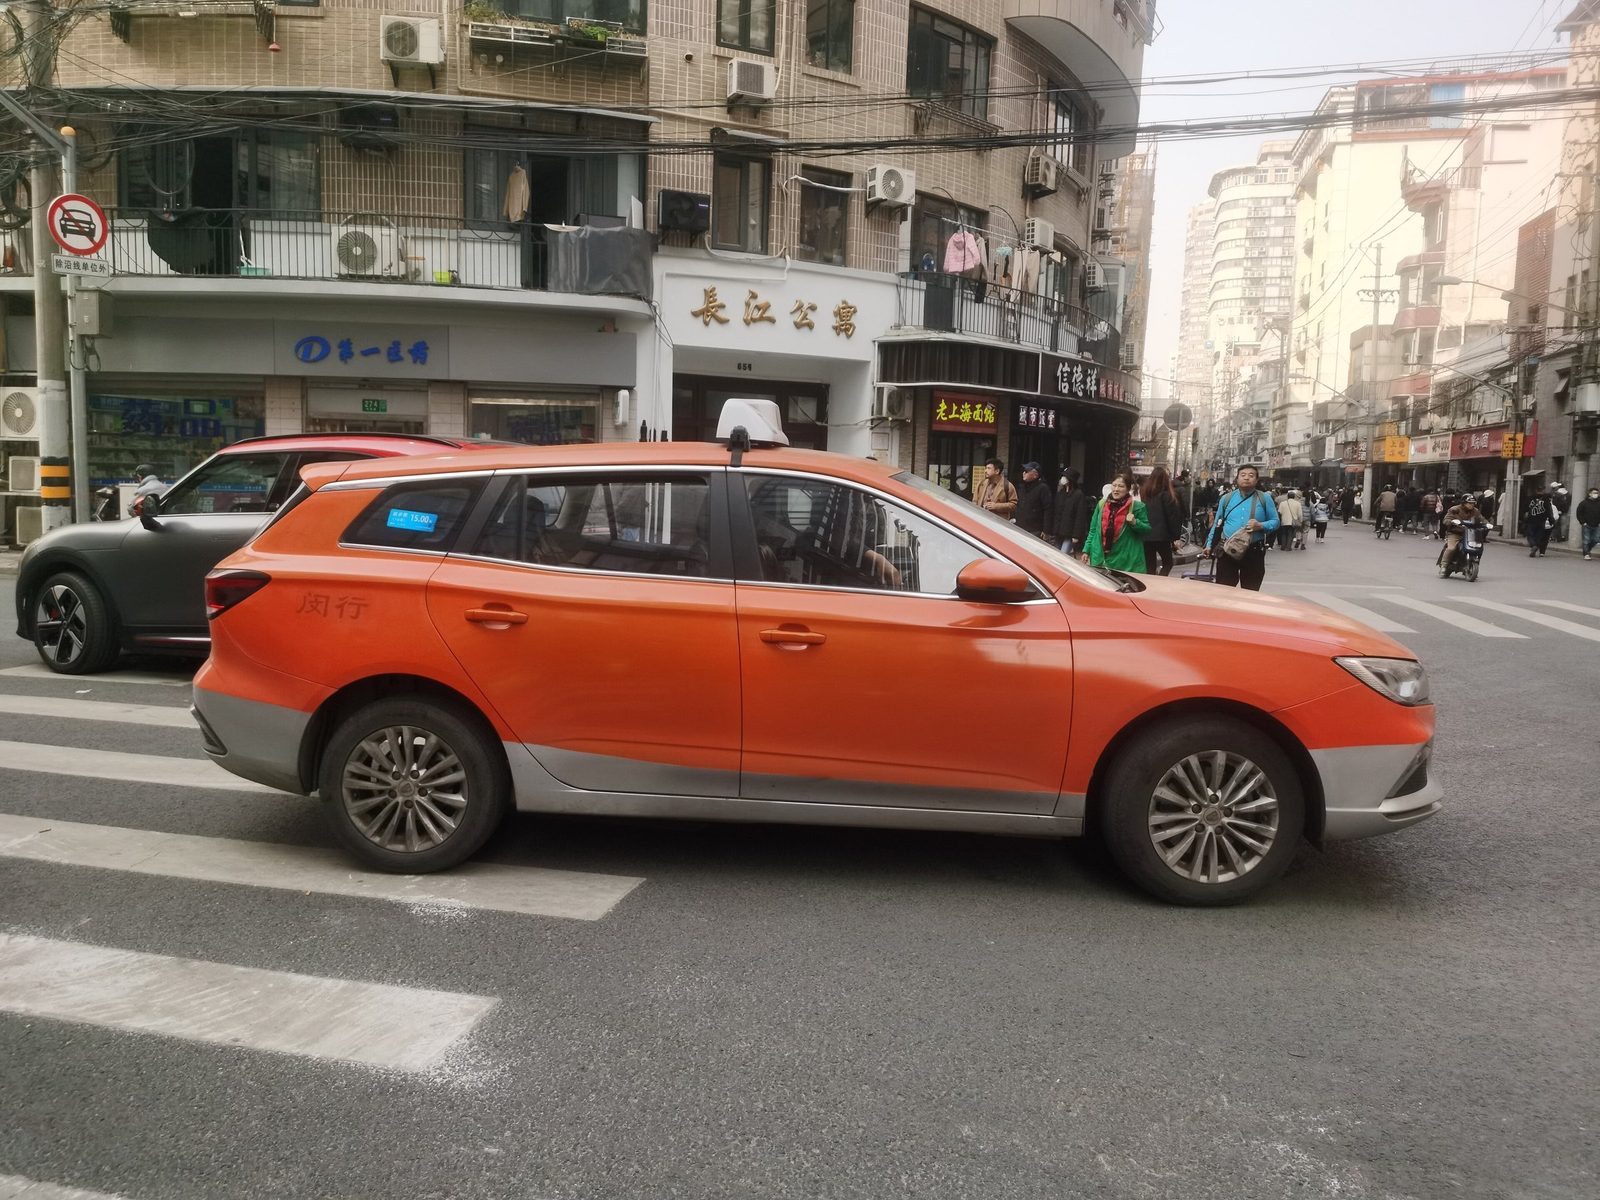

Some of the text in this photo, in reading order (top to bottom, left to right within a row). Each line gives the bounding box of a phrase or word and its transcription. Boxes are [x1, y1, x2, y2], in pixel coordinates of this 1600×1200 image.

[55, 258, 107, 274] 除沿线单位外
[1056, 361, 1098, 399] 信德祥
[936, 399, 996, 423] 老上海面馆
[296, 592, 369, 620] 闵行
